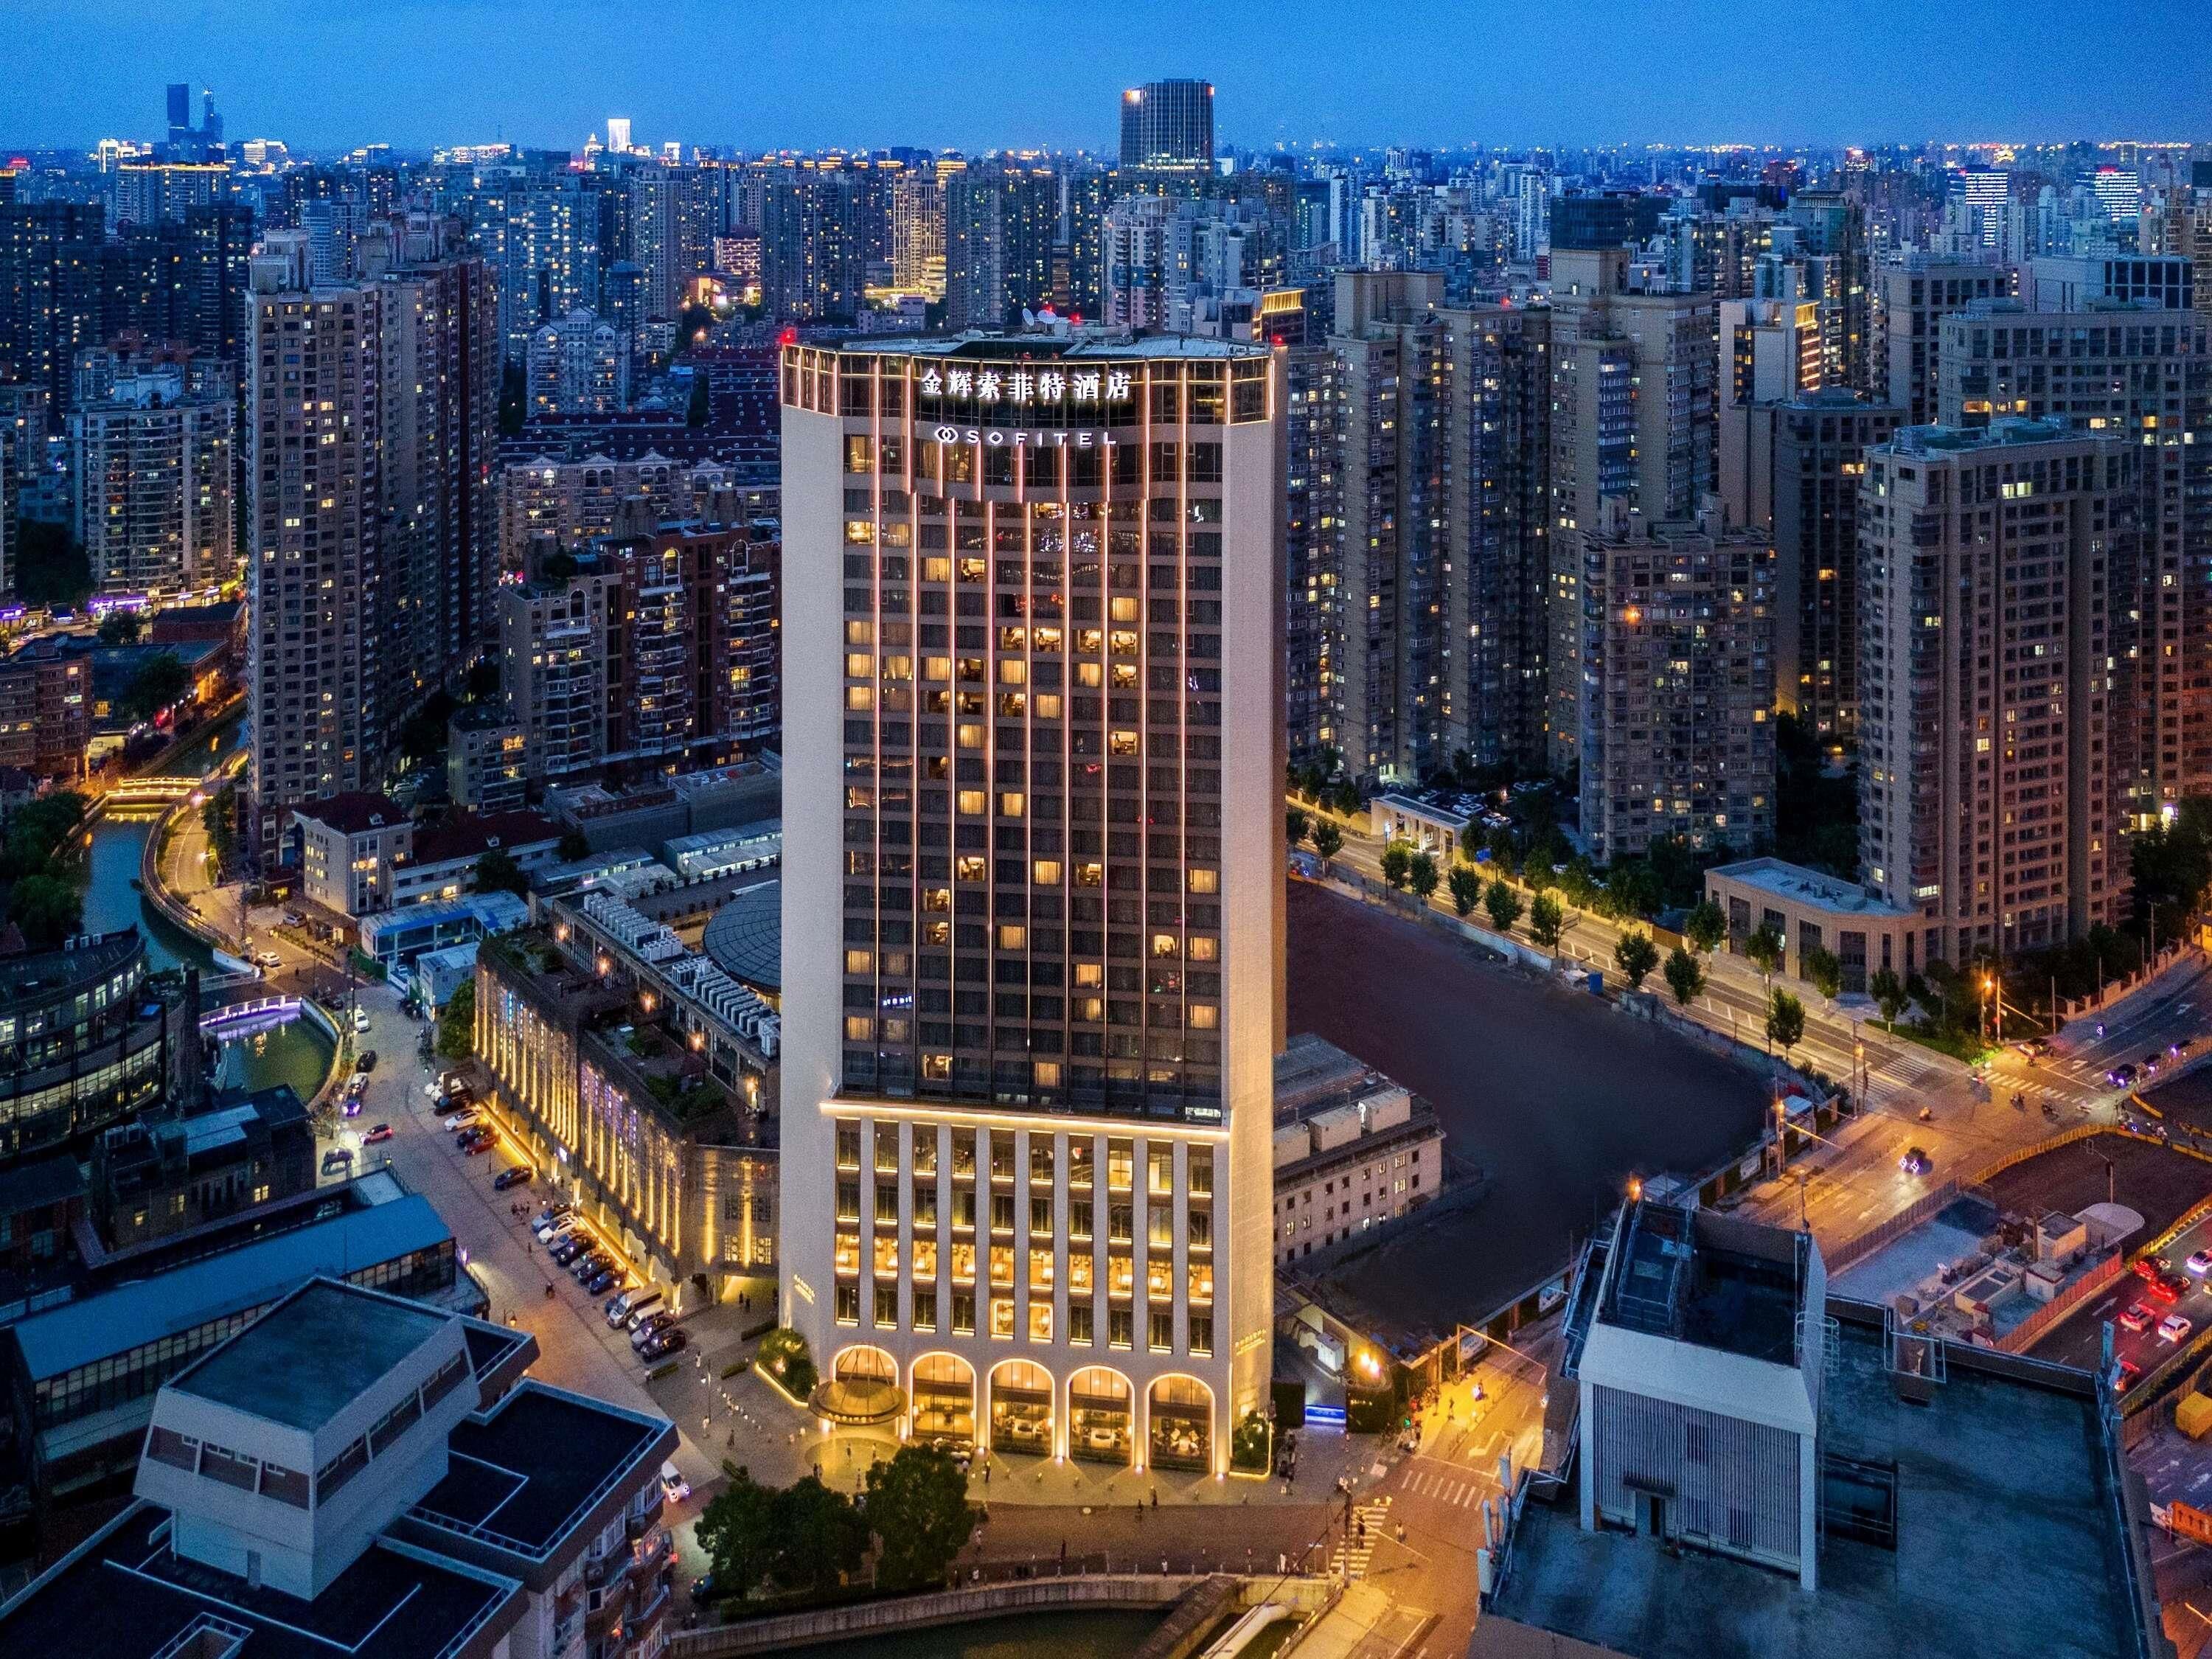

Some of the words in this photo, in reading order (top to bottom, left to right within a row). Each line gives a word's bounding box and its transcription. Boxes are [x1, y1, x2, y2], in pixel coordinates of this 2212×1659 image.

[921, 369, 1132, 400] 金辉索菲特酒店
[967, 431, 1116, 446] SOFITEL
